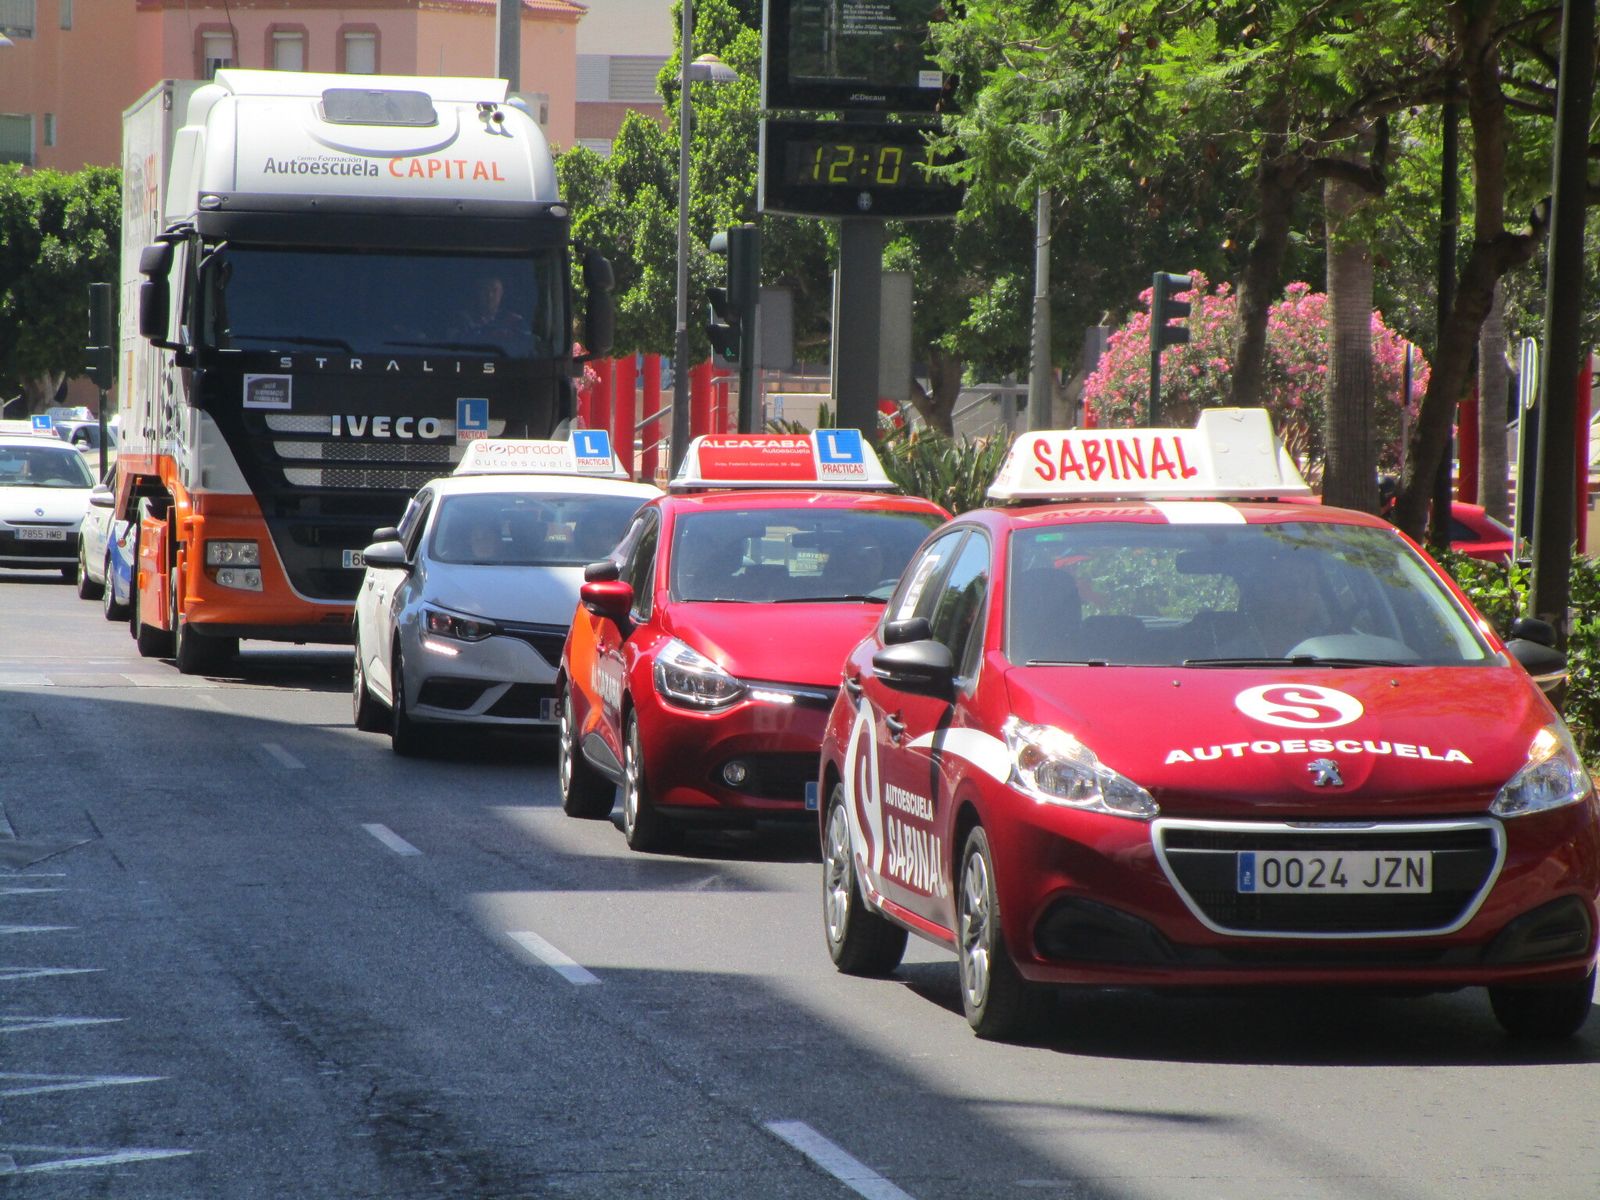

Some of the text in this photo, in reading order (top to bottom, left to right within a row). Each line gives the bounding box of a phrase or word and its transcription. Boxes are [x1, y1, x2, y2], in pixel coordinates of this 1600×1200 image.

[263, 157, 506, 181] Autoescuela CAPITAL
[280, 356, 495, 374] STRALIS
[465, 404, 480, 426] L
[331, 415, 441, 439] IVECO
[585, 436, 599, 454] L
[700, 439, 809, 448] ALCAZABA
[762, 447, 810, 455] Autoescuela
[828, 435, 852, 459] L
[475, 458, 572, 468] autoescuela
[578, 458, 610, 466] PRACTICAS
[822, 464, 864, 474] PRACTICAS
[1033, 436, 1198, 481] SABINAL
[1165, 739, 1473, 764] AUTOESCUELA
[886, 783, 933, 822] AUTOESCUELA
[888, 815, 948, 898] SABINAL
[1263, 857, 1348, 888] 0024
[1362, 857, 1424, 888] JZN
